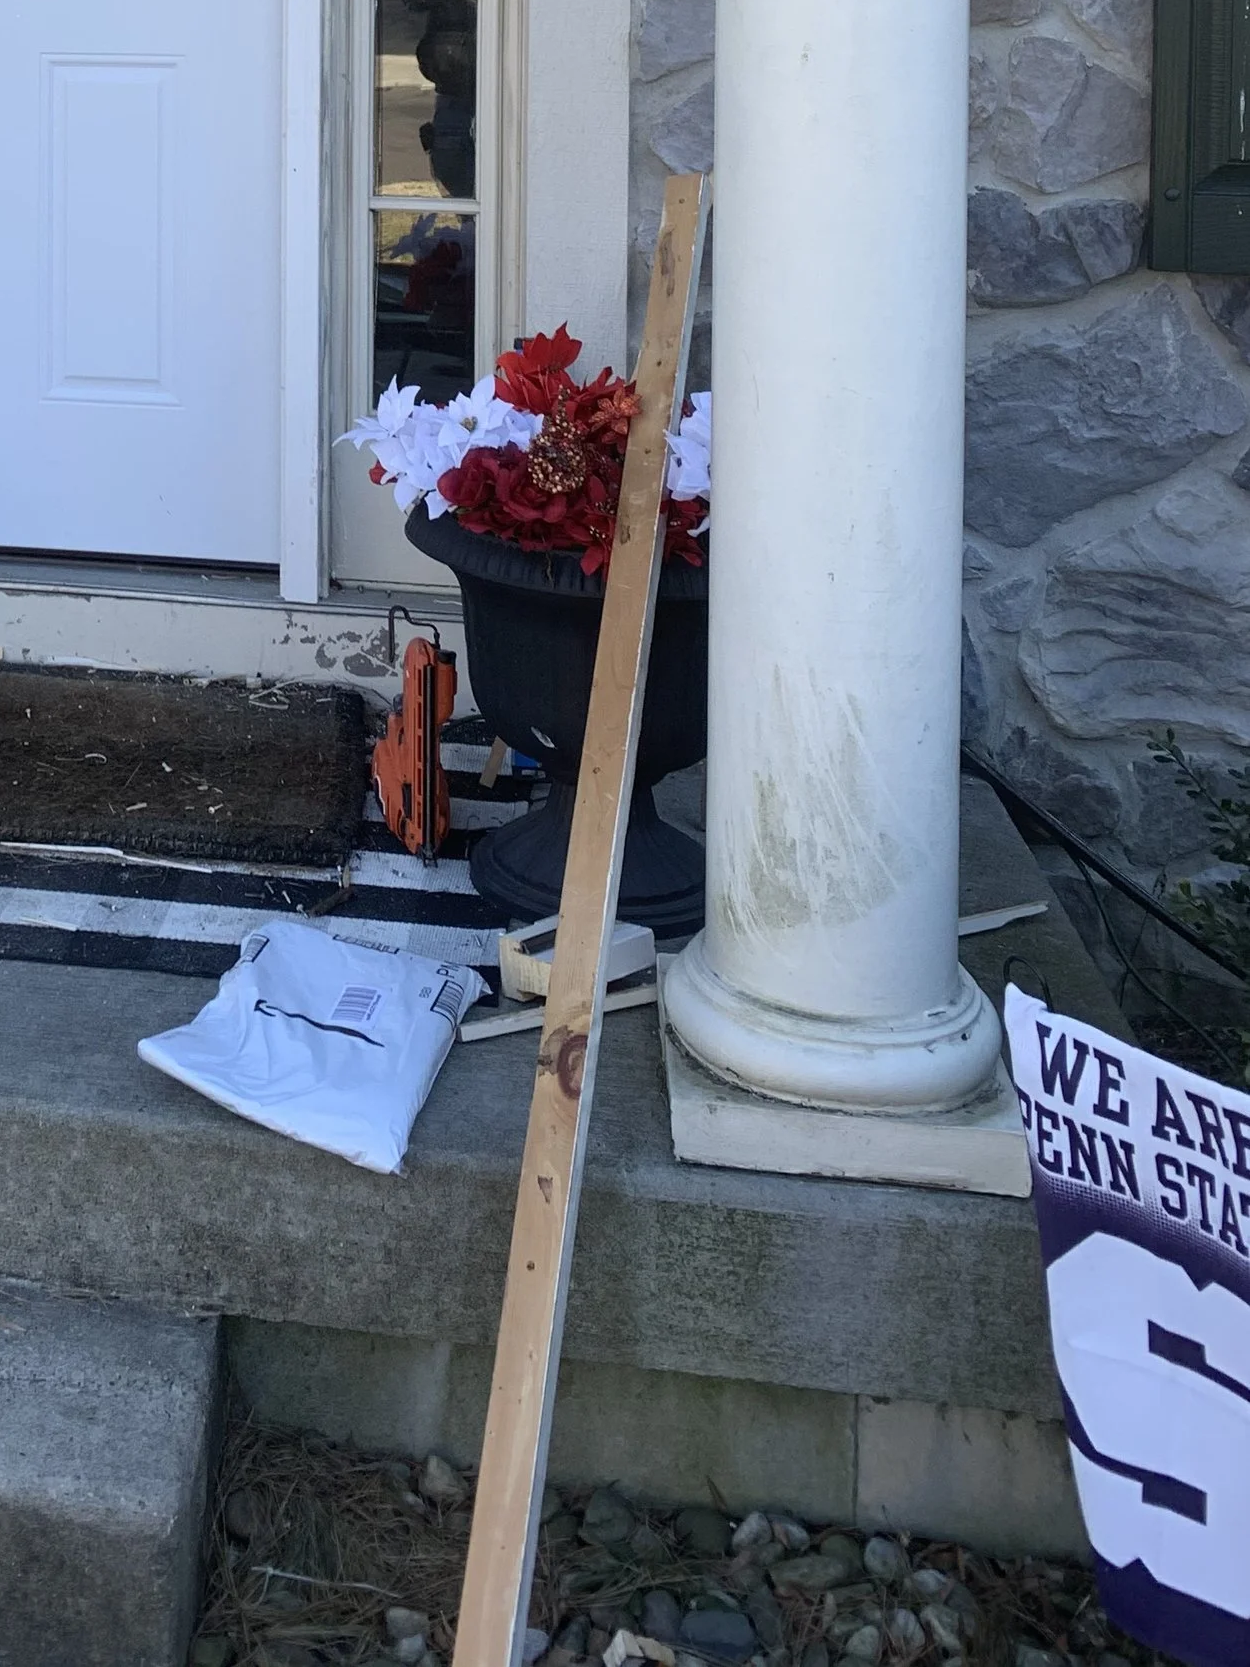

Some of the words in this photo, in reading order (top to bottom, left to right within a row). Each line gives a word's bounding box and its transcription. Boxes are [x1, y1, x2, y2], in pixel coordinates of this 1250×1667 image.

[1036, 1020, 1130, 1127] WE
[1151, 1077, 1250, 1182] ARE
[1155, 1153, 1250, 1257] STA
